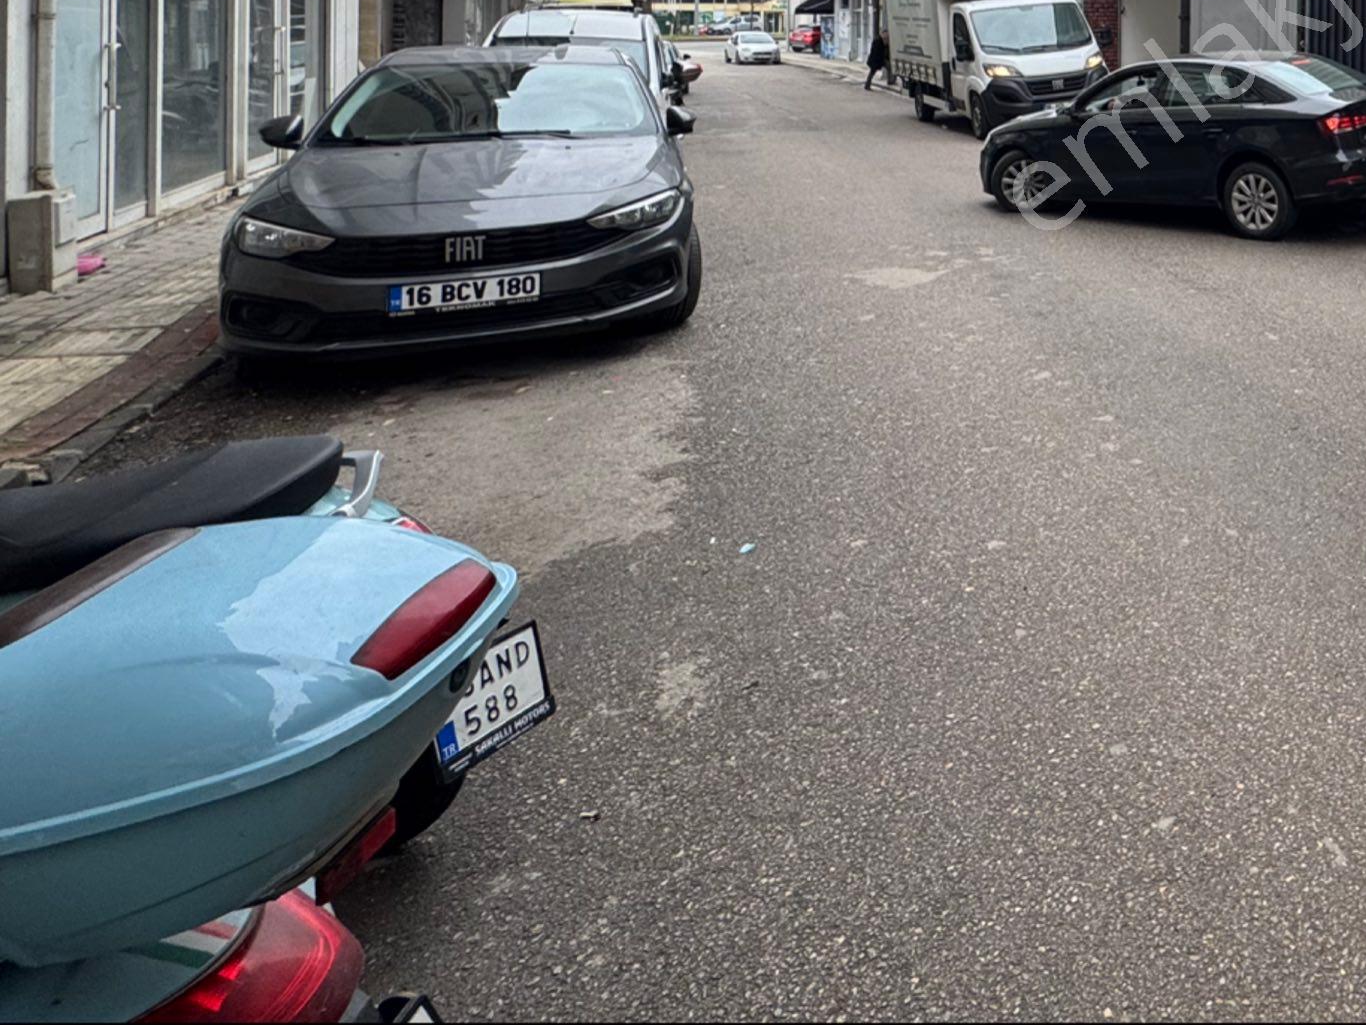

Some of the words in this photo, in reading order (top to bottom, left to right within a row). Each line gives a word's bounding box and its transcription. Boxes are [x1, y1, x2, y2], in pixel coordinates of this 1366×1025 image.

[444, 235, 487, 263] FIAT
[406, 286, 432, 307] 16
[441, 280, 488, 304] BCV
[496, 275, 536, 297] 180
[464, 684, 518, 736] 588
[513, 700, 551, 729] MOTORS
[442, 743, 459, 760] TR
